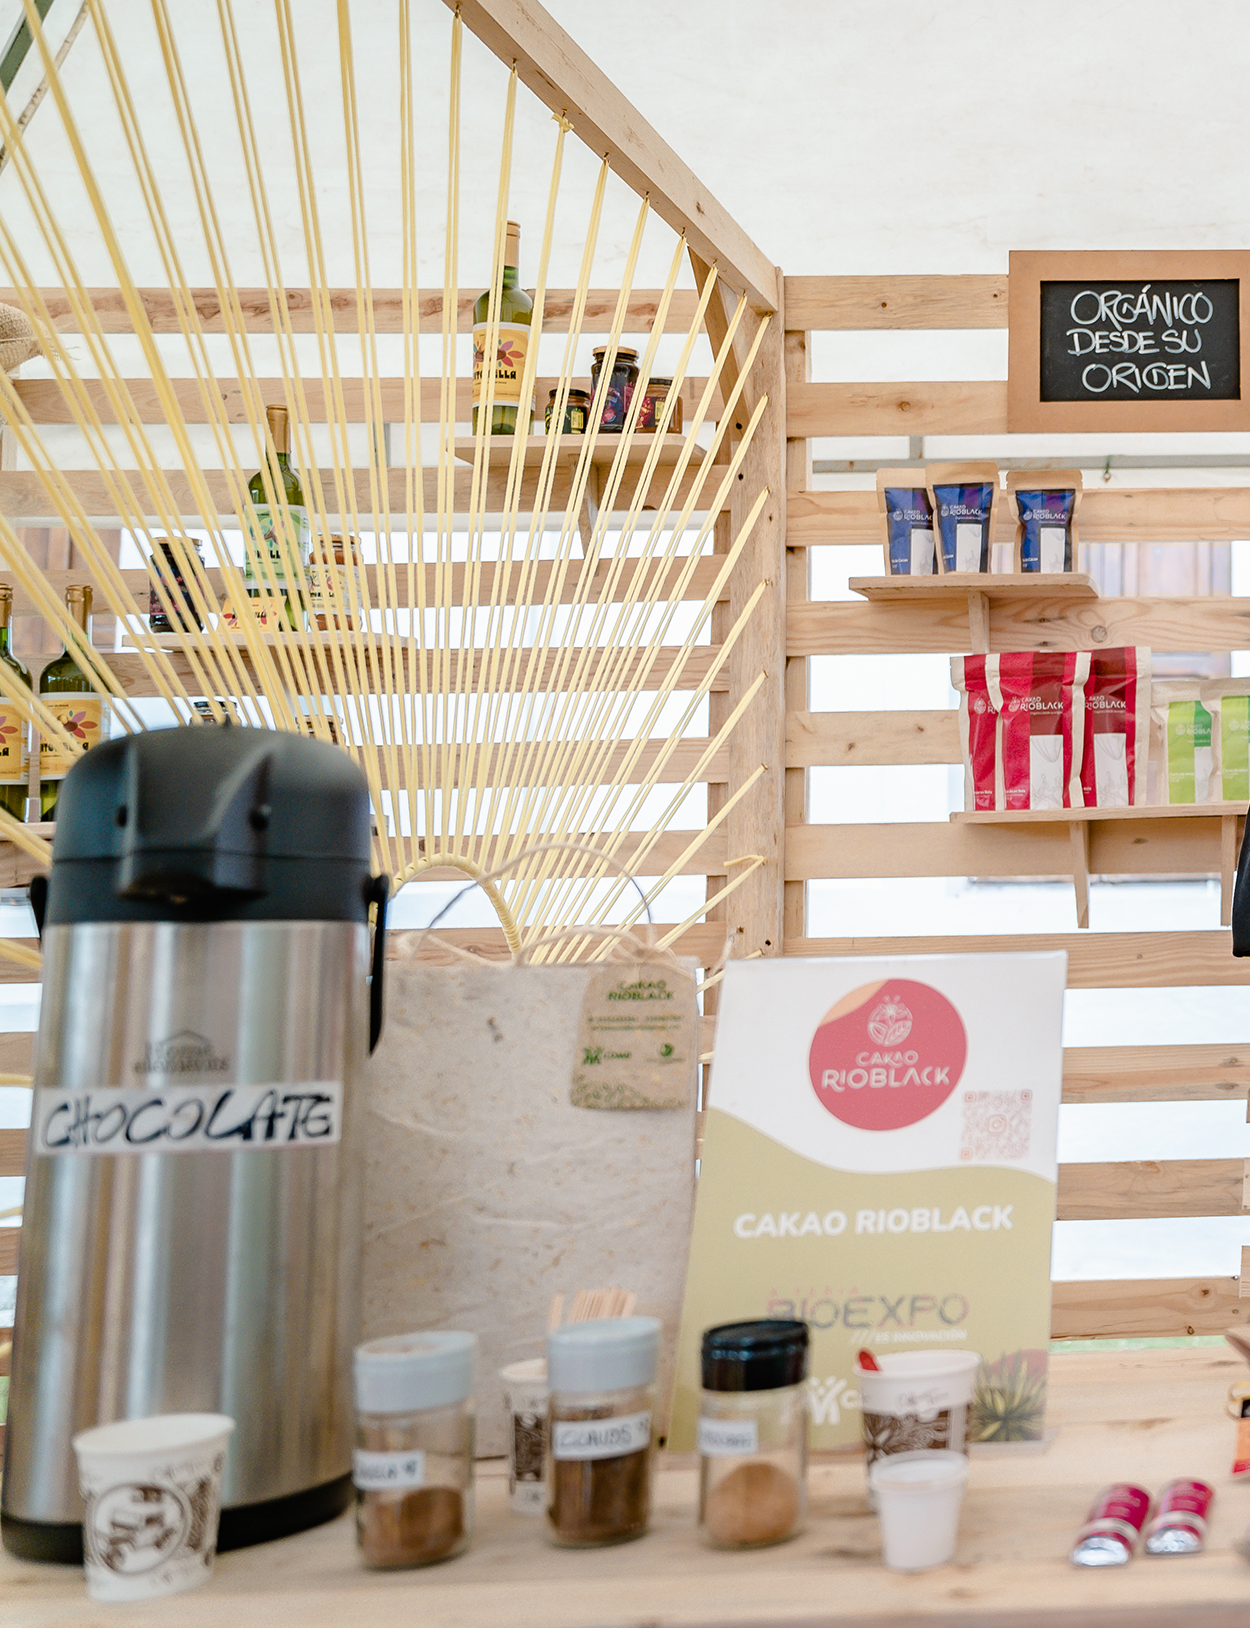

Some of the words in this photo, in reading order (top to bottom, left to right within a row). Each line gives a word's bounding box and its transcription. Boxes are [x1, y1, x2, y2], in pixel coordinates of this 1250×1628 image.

[1070, 284, 1213, 331] ORGÁNICO
[1066, 328, 1160, 356] DESDE
[1161, 328, 1202, 354] SU
[1082, 360, 1211, 393] ORIGEN
[1020, 701, 1063, 711] RIOBLACK
[855, 1050, 919, 1067] CAKAO
[821, 1066, 950, 1092] RIOBLACK
[45, 1089, 331, 1147] CHOCOLATE
[734, 1209, 848, 1239] CAKAO
[856, 1204, 1014, 1236] RIOBLACK
[768, 1293, 970, 1329] BIOEXPO
